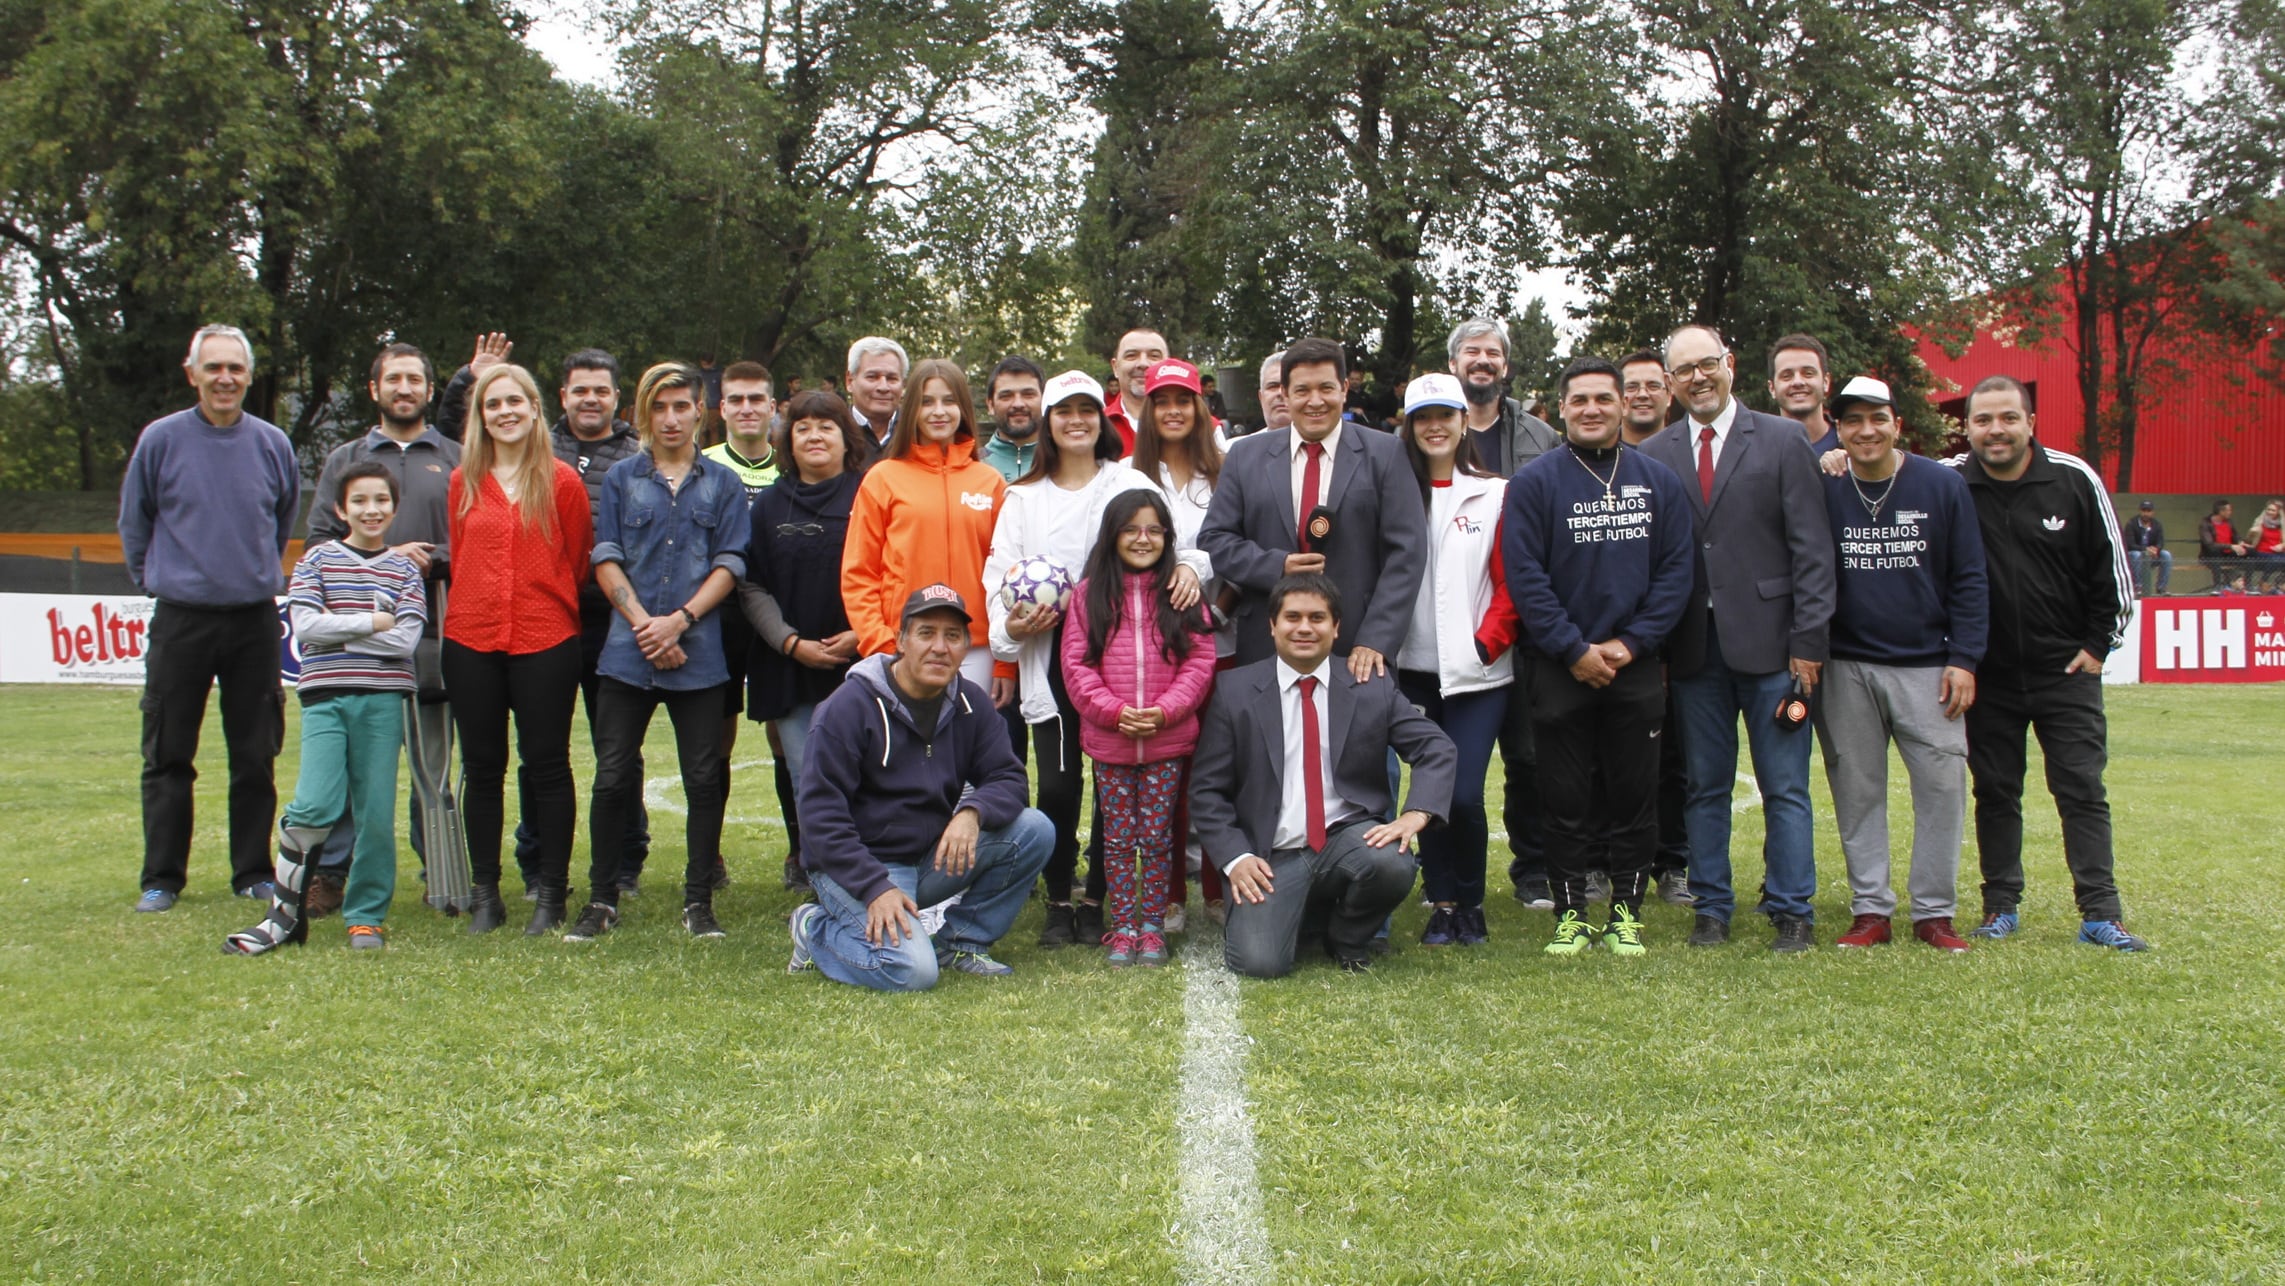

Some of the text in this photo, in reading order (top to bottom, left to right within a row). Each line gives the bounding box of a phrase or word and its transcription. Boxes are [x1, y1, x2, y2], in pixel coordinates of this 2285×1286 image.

[1573, 498, 1646, 514] QUEREMOS
[1567, 512, 1652, 529] TERCER TIEMPO
[1574, 526, 1649, 543] EN EL FUTBOL
[1843, 525, 1919, 539] QUEREMOS
[1840, 540, 1926, 555] TERCER TIEMPO
[1844, 555, 1920, 570] EN EL FUTBOL
[47, 602, 145, 666] beltr
[2155, 609, 2246, 669] HH
[2254, 632, 2285, 647] MA
